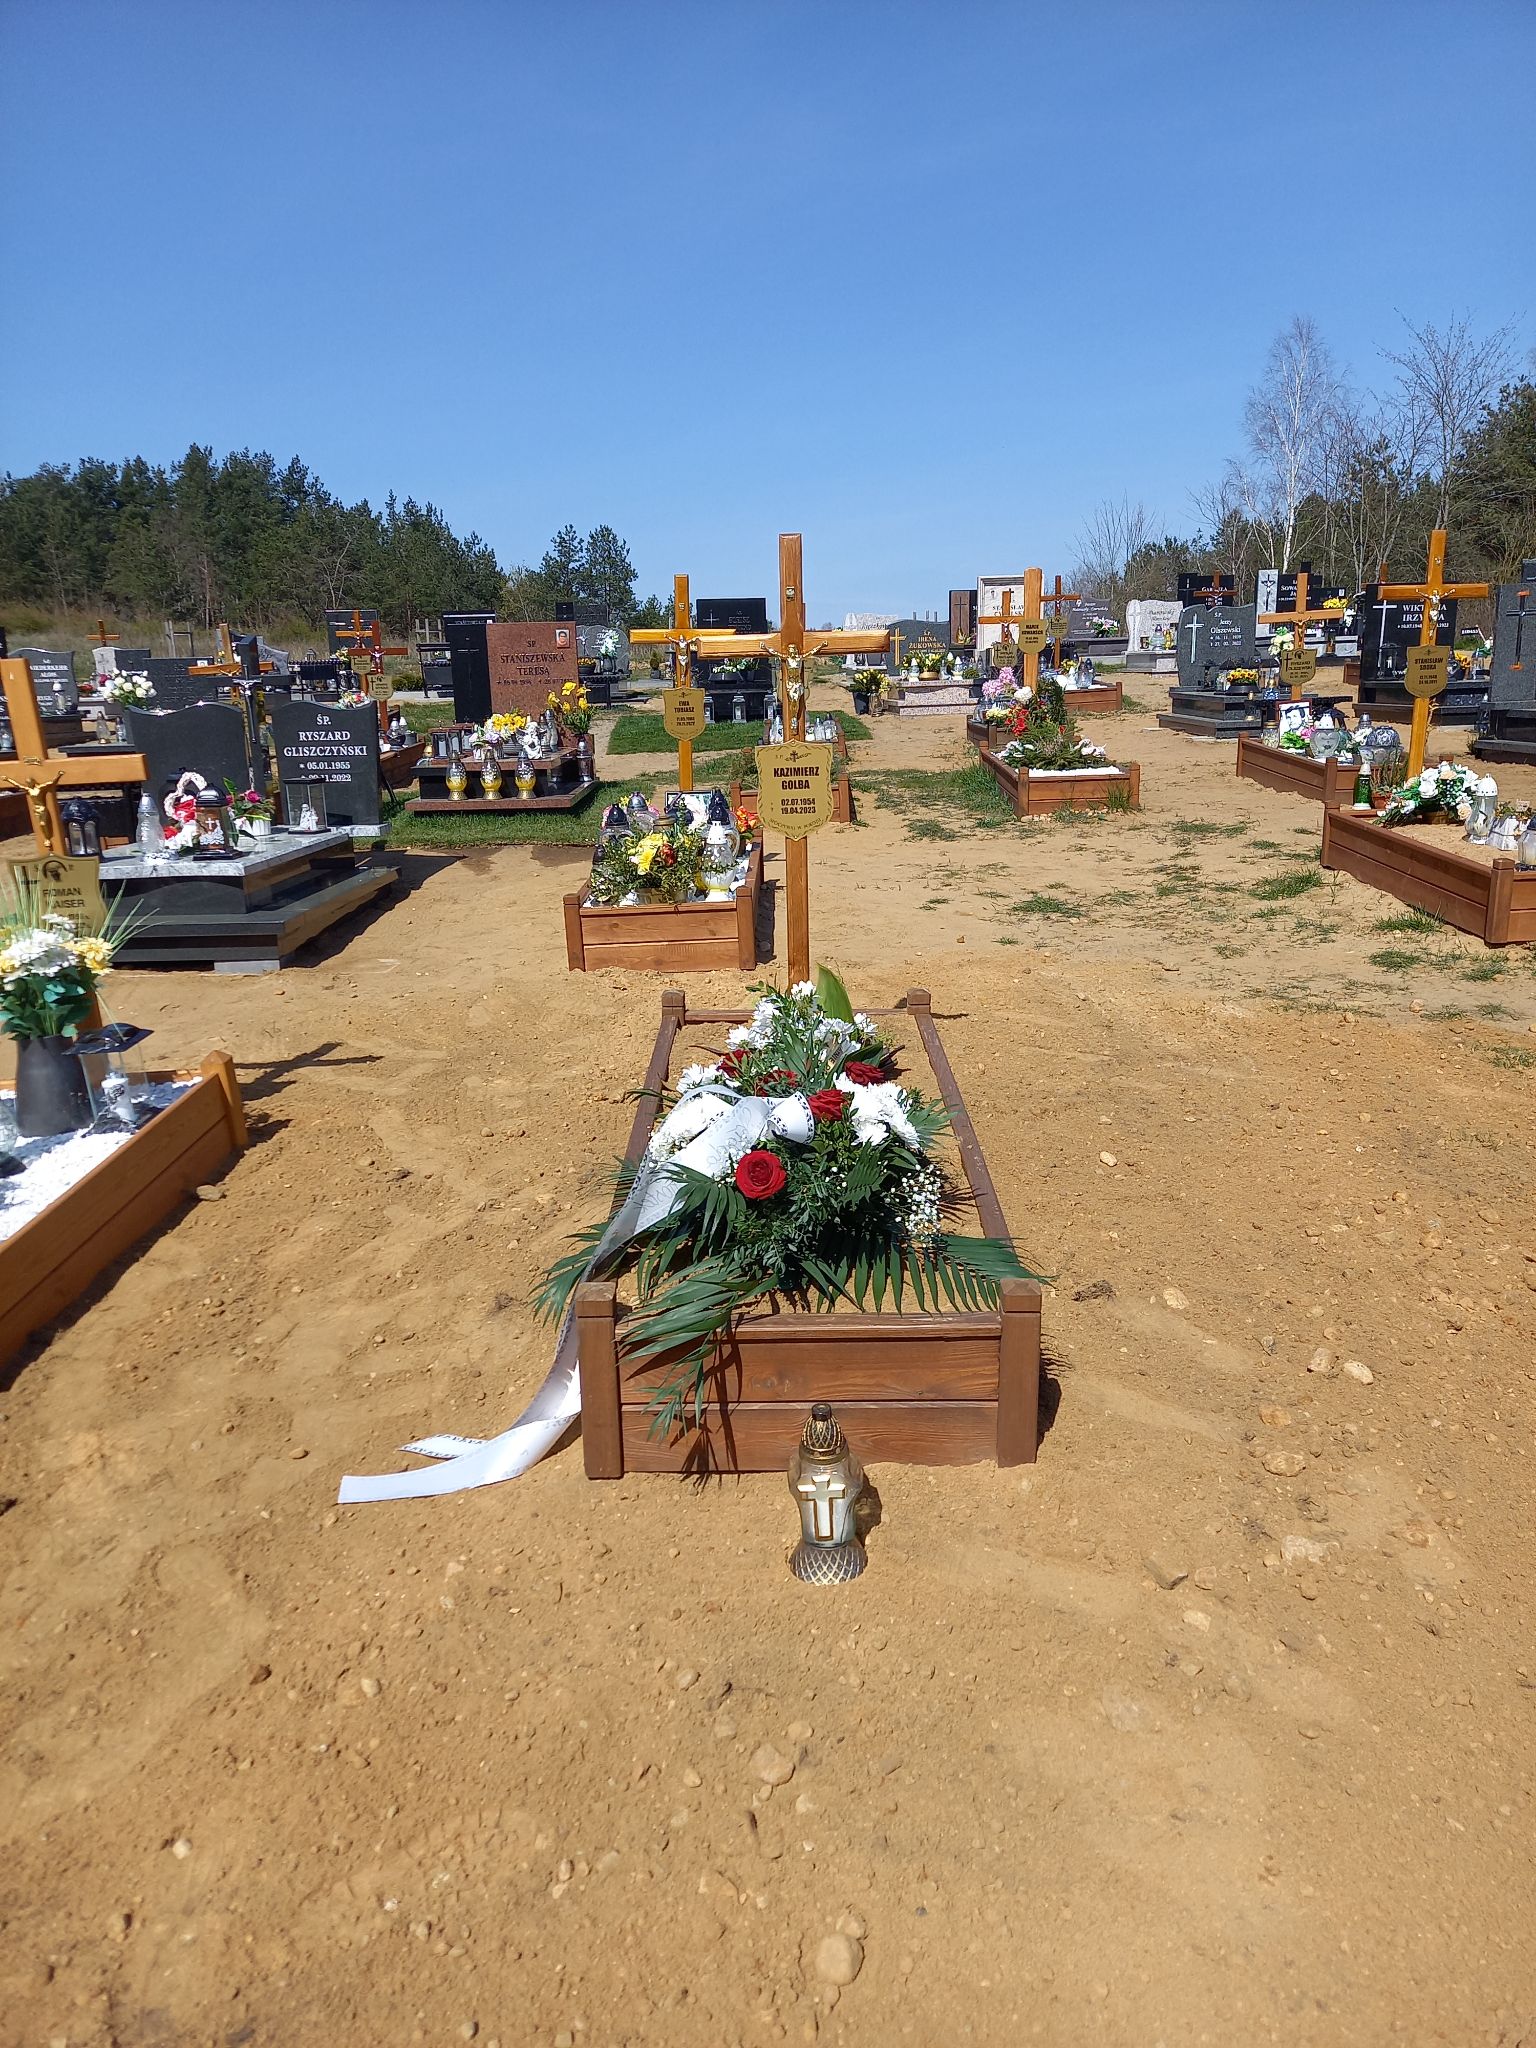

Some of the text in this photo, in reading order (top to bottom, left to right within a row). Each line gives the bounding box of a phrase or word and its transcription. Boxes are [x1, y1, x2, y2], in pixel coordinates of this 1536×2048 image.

[1402, 604, 1447, 612] WIKTIA
[1210, 626, 1241, 634] Olszewski
[501, 652, 566, 664] STANISZEWSKA
[517, 666, 549, 677] TERESA
[317, 713, 331, 725] ŚP.
[298, 731, 351, 742] RYSZARD
[284, 744, 368, 757] GLISZCZYŃSKI
[307, 761, 351, 770] 05.01.1955
[773, 766, 820, 778] KAZIMIERZ
[781, 779, 811, 791] GOLBA
[781, 797, 816, 807] 02.07.1954
[781, 806, 817, 816] 19.04.2023
[43, 887, 82, 898] ROMAN
